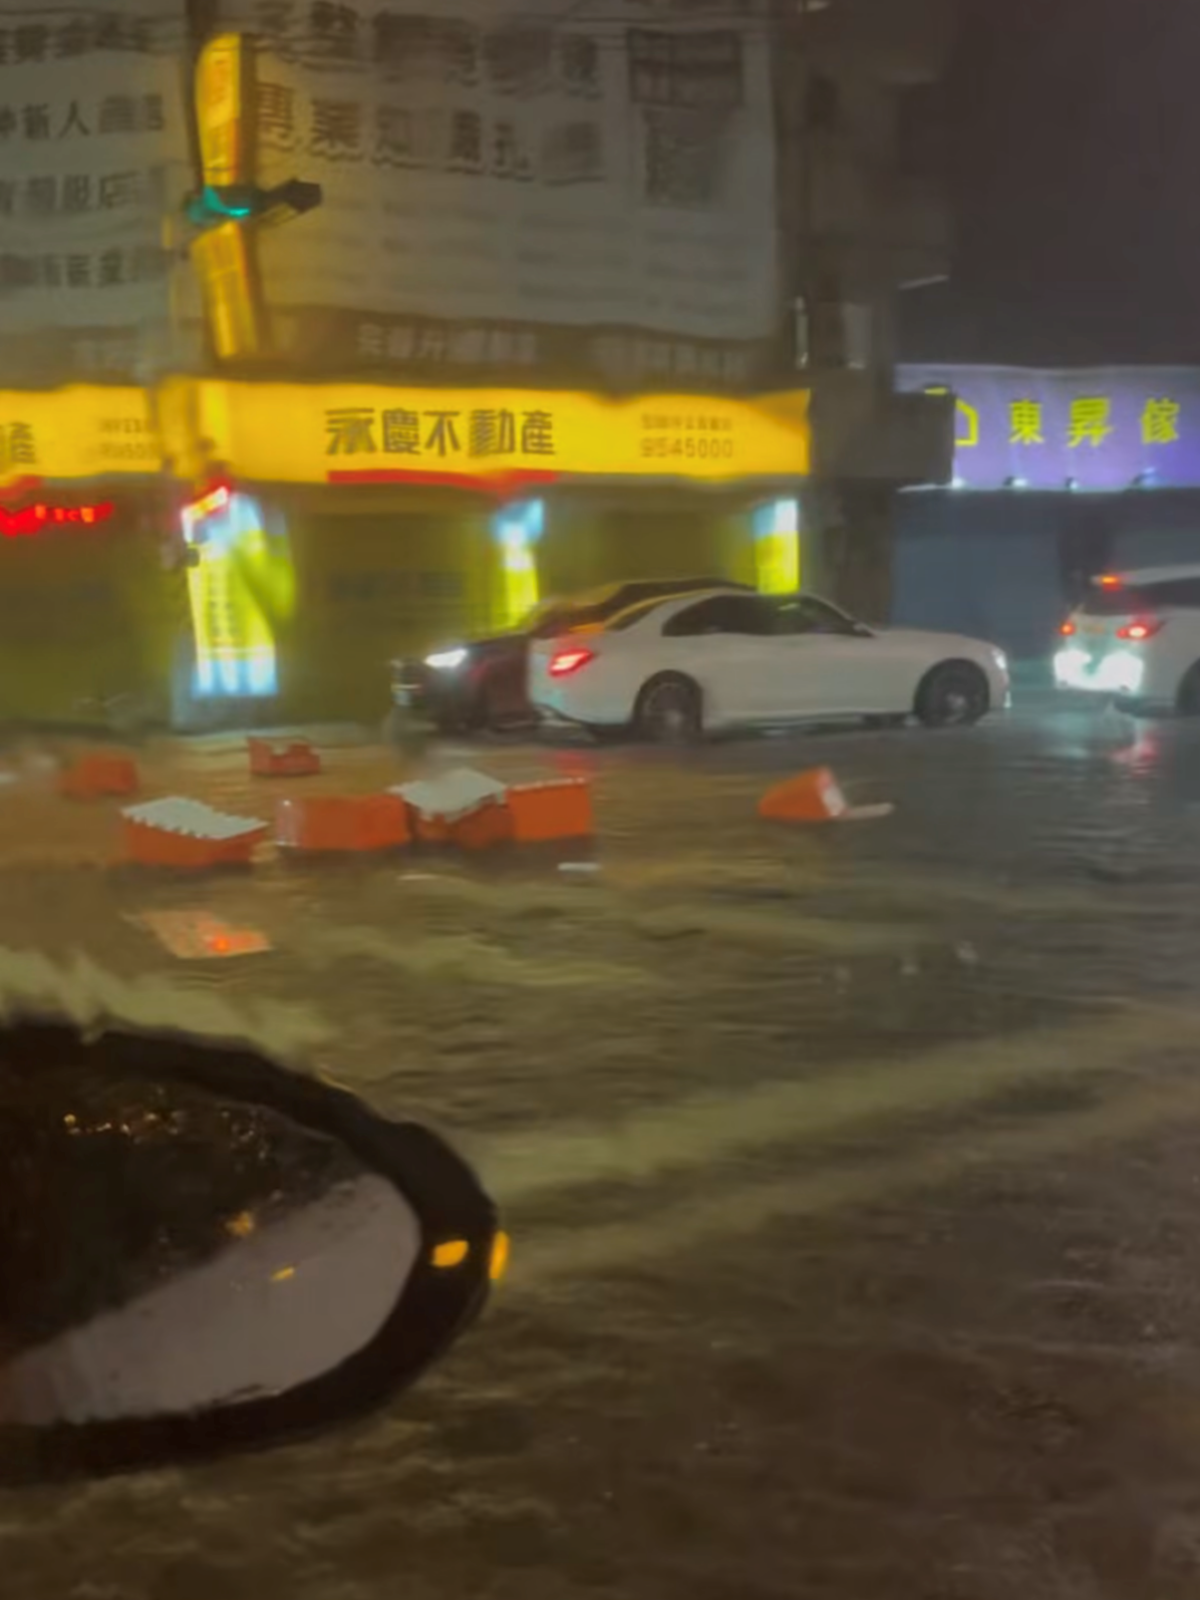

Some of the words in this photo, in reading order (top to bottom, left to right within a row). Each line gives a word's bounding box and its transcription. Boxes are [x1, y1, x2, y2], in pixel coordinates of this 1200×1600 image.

[325, 408, 556, 457] 永慶不動產
